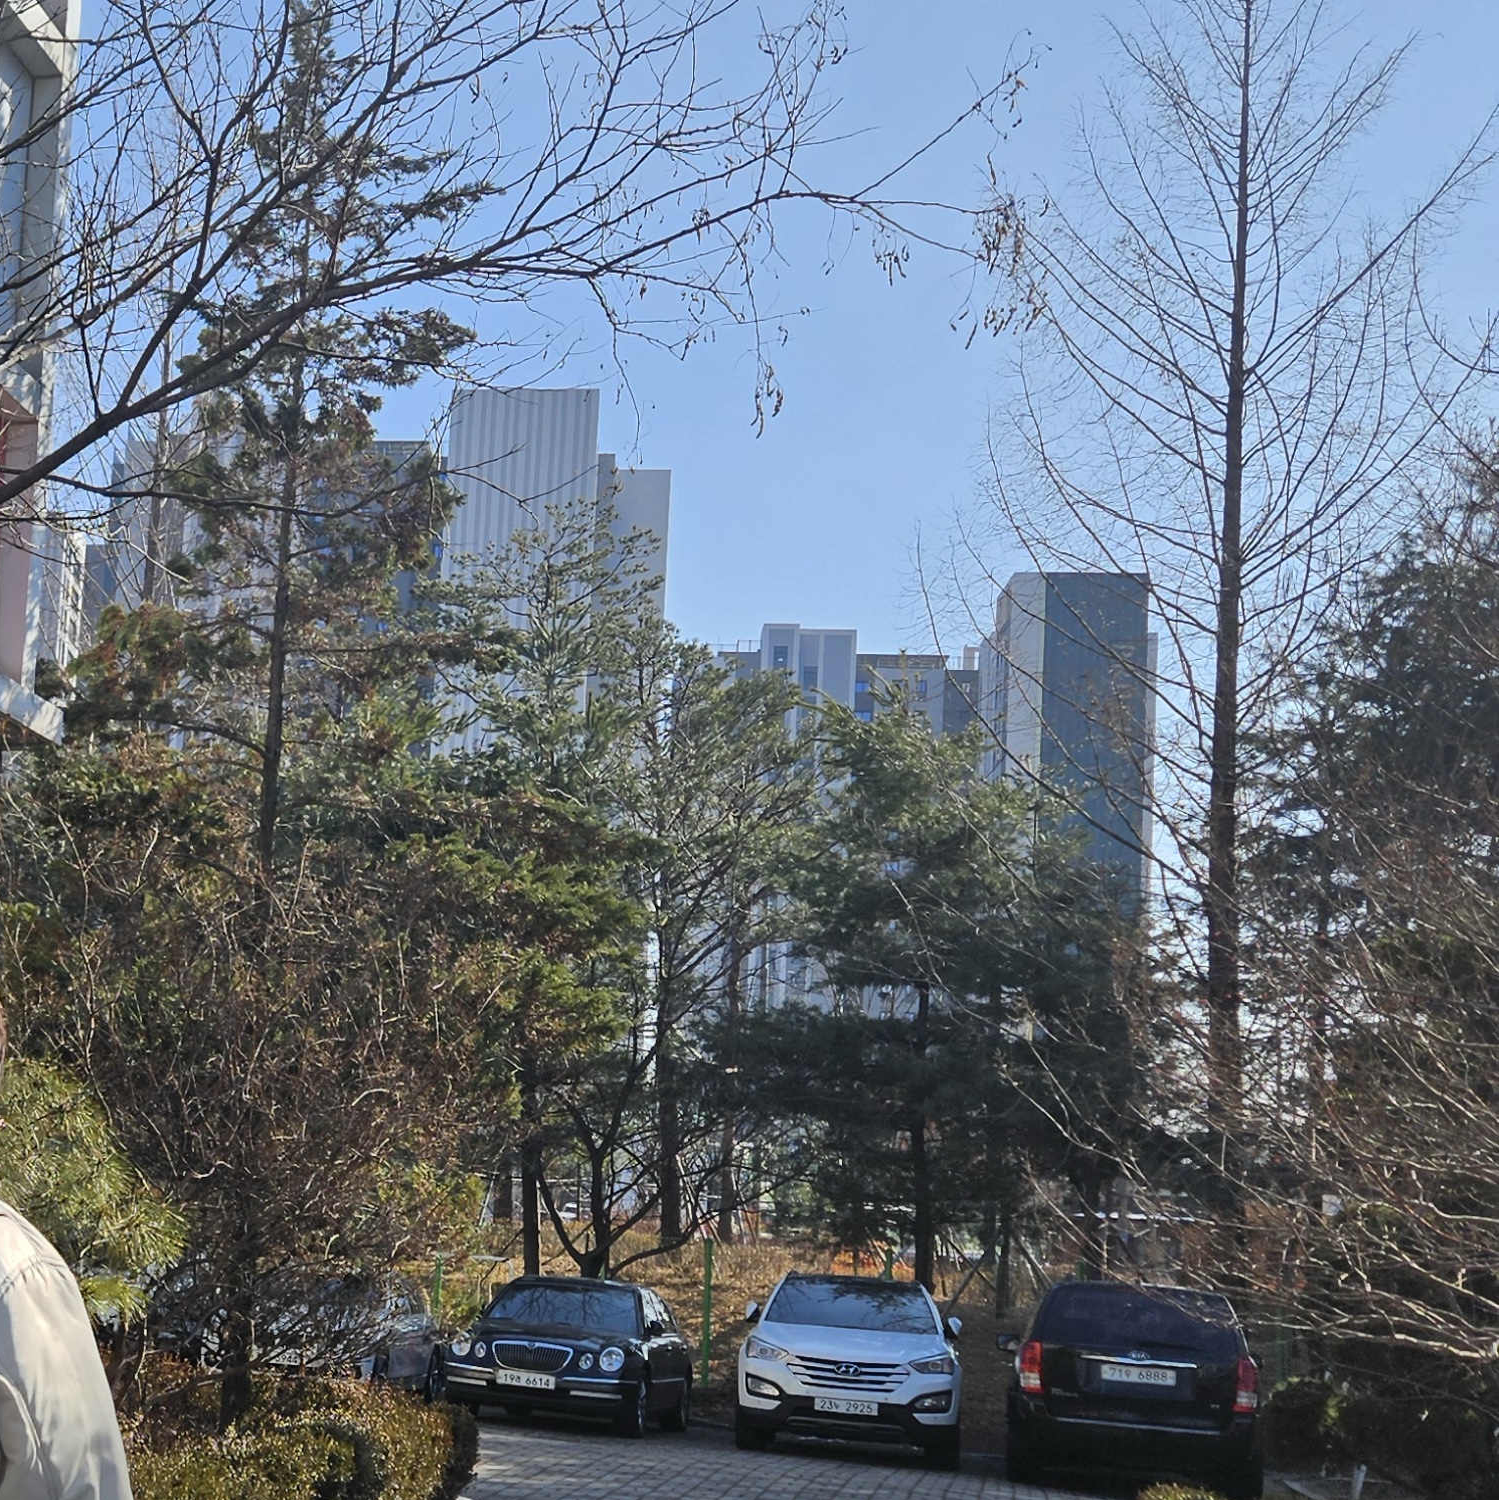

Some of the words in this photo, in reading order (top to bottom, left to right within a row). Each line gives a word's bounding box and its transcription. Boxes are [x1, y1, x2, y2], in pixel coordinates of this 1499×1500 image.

[1137, 1369, 1168, 1382] 6888
[525, 1376, 550, 1388] 6614
[845, 1402, 873, 1414] 2925
